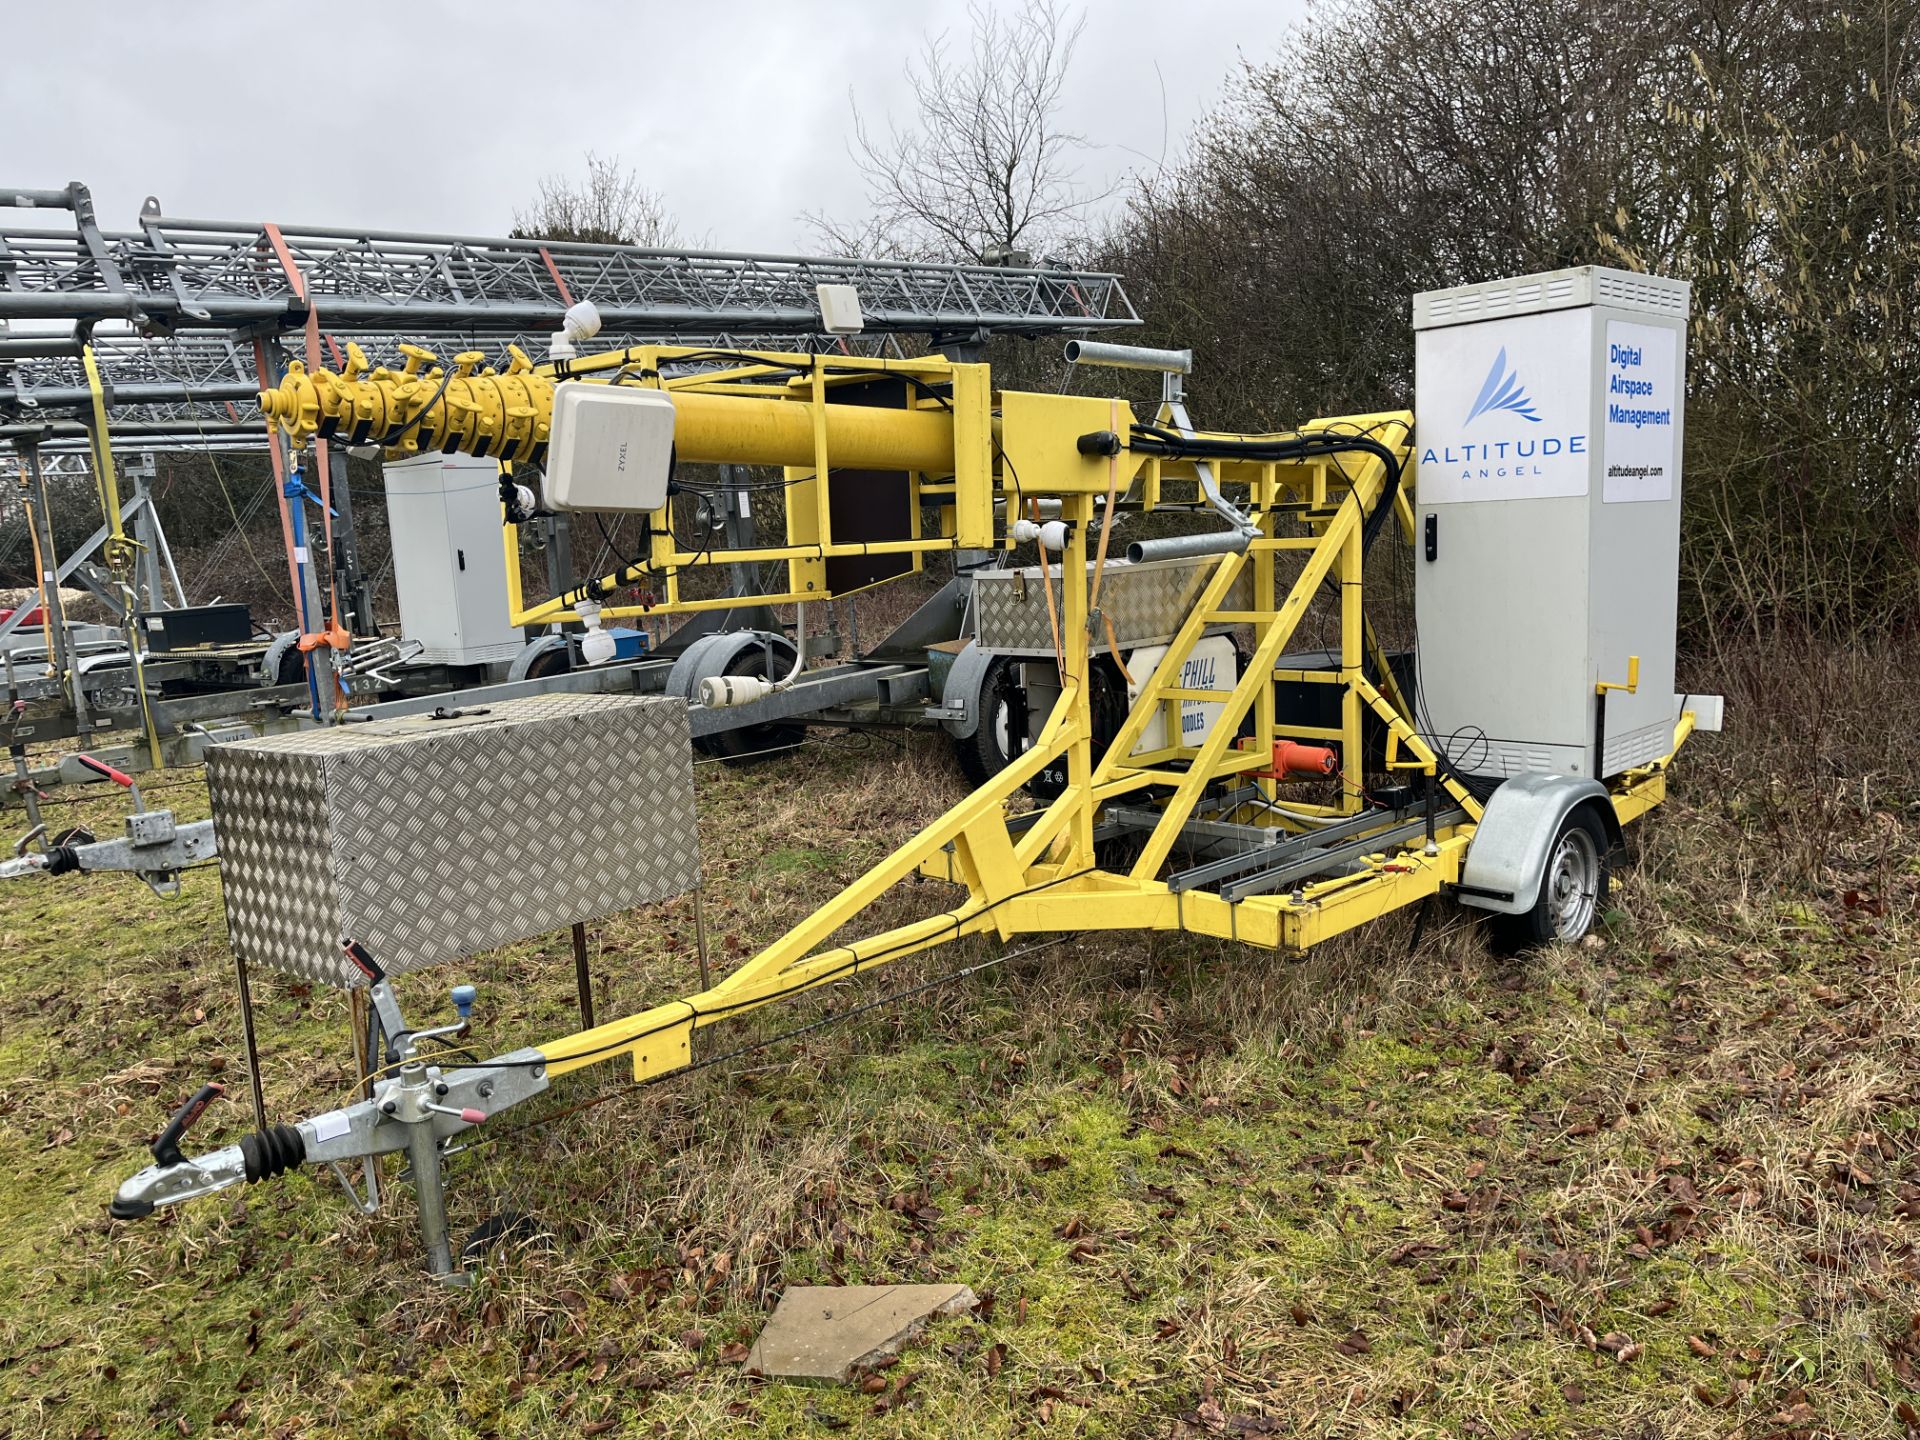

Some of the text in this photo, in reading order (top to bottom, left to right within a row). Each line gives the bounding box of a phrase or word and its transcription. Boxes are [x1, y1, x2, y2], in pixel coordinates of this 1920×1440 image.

[1610, 344, 1641, 369] Digital
[1610, 374, 1652, 399] Airspace
[1609, 404, 1670, 429] Management
[617, 441, 628, 472] ZYXEL
[1421, 436, 1586, 465] ALTITUDE
[1462, 465, 1542, 480] ANGEL
[1608, 465, 1663, 480] altitudeangel.com
[1180, 657, 1215, 688] PHILL
